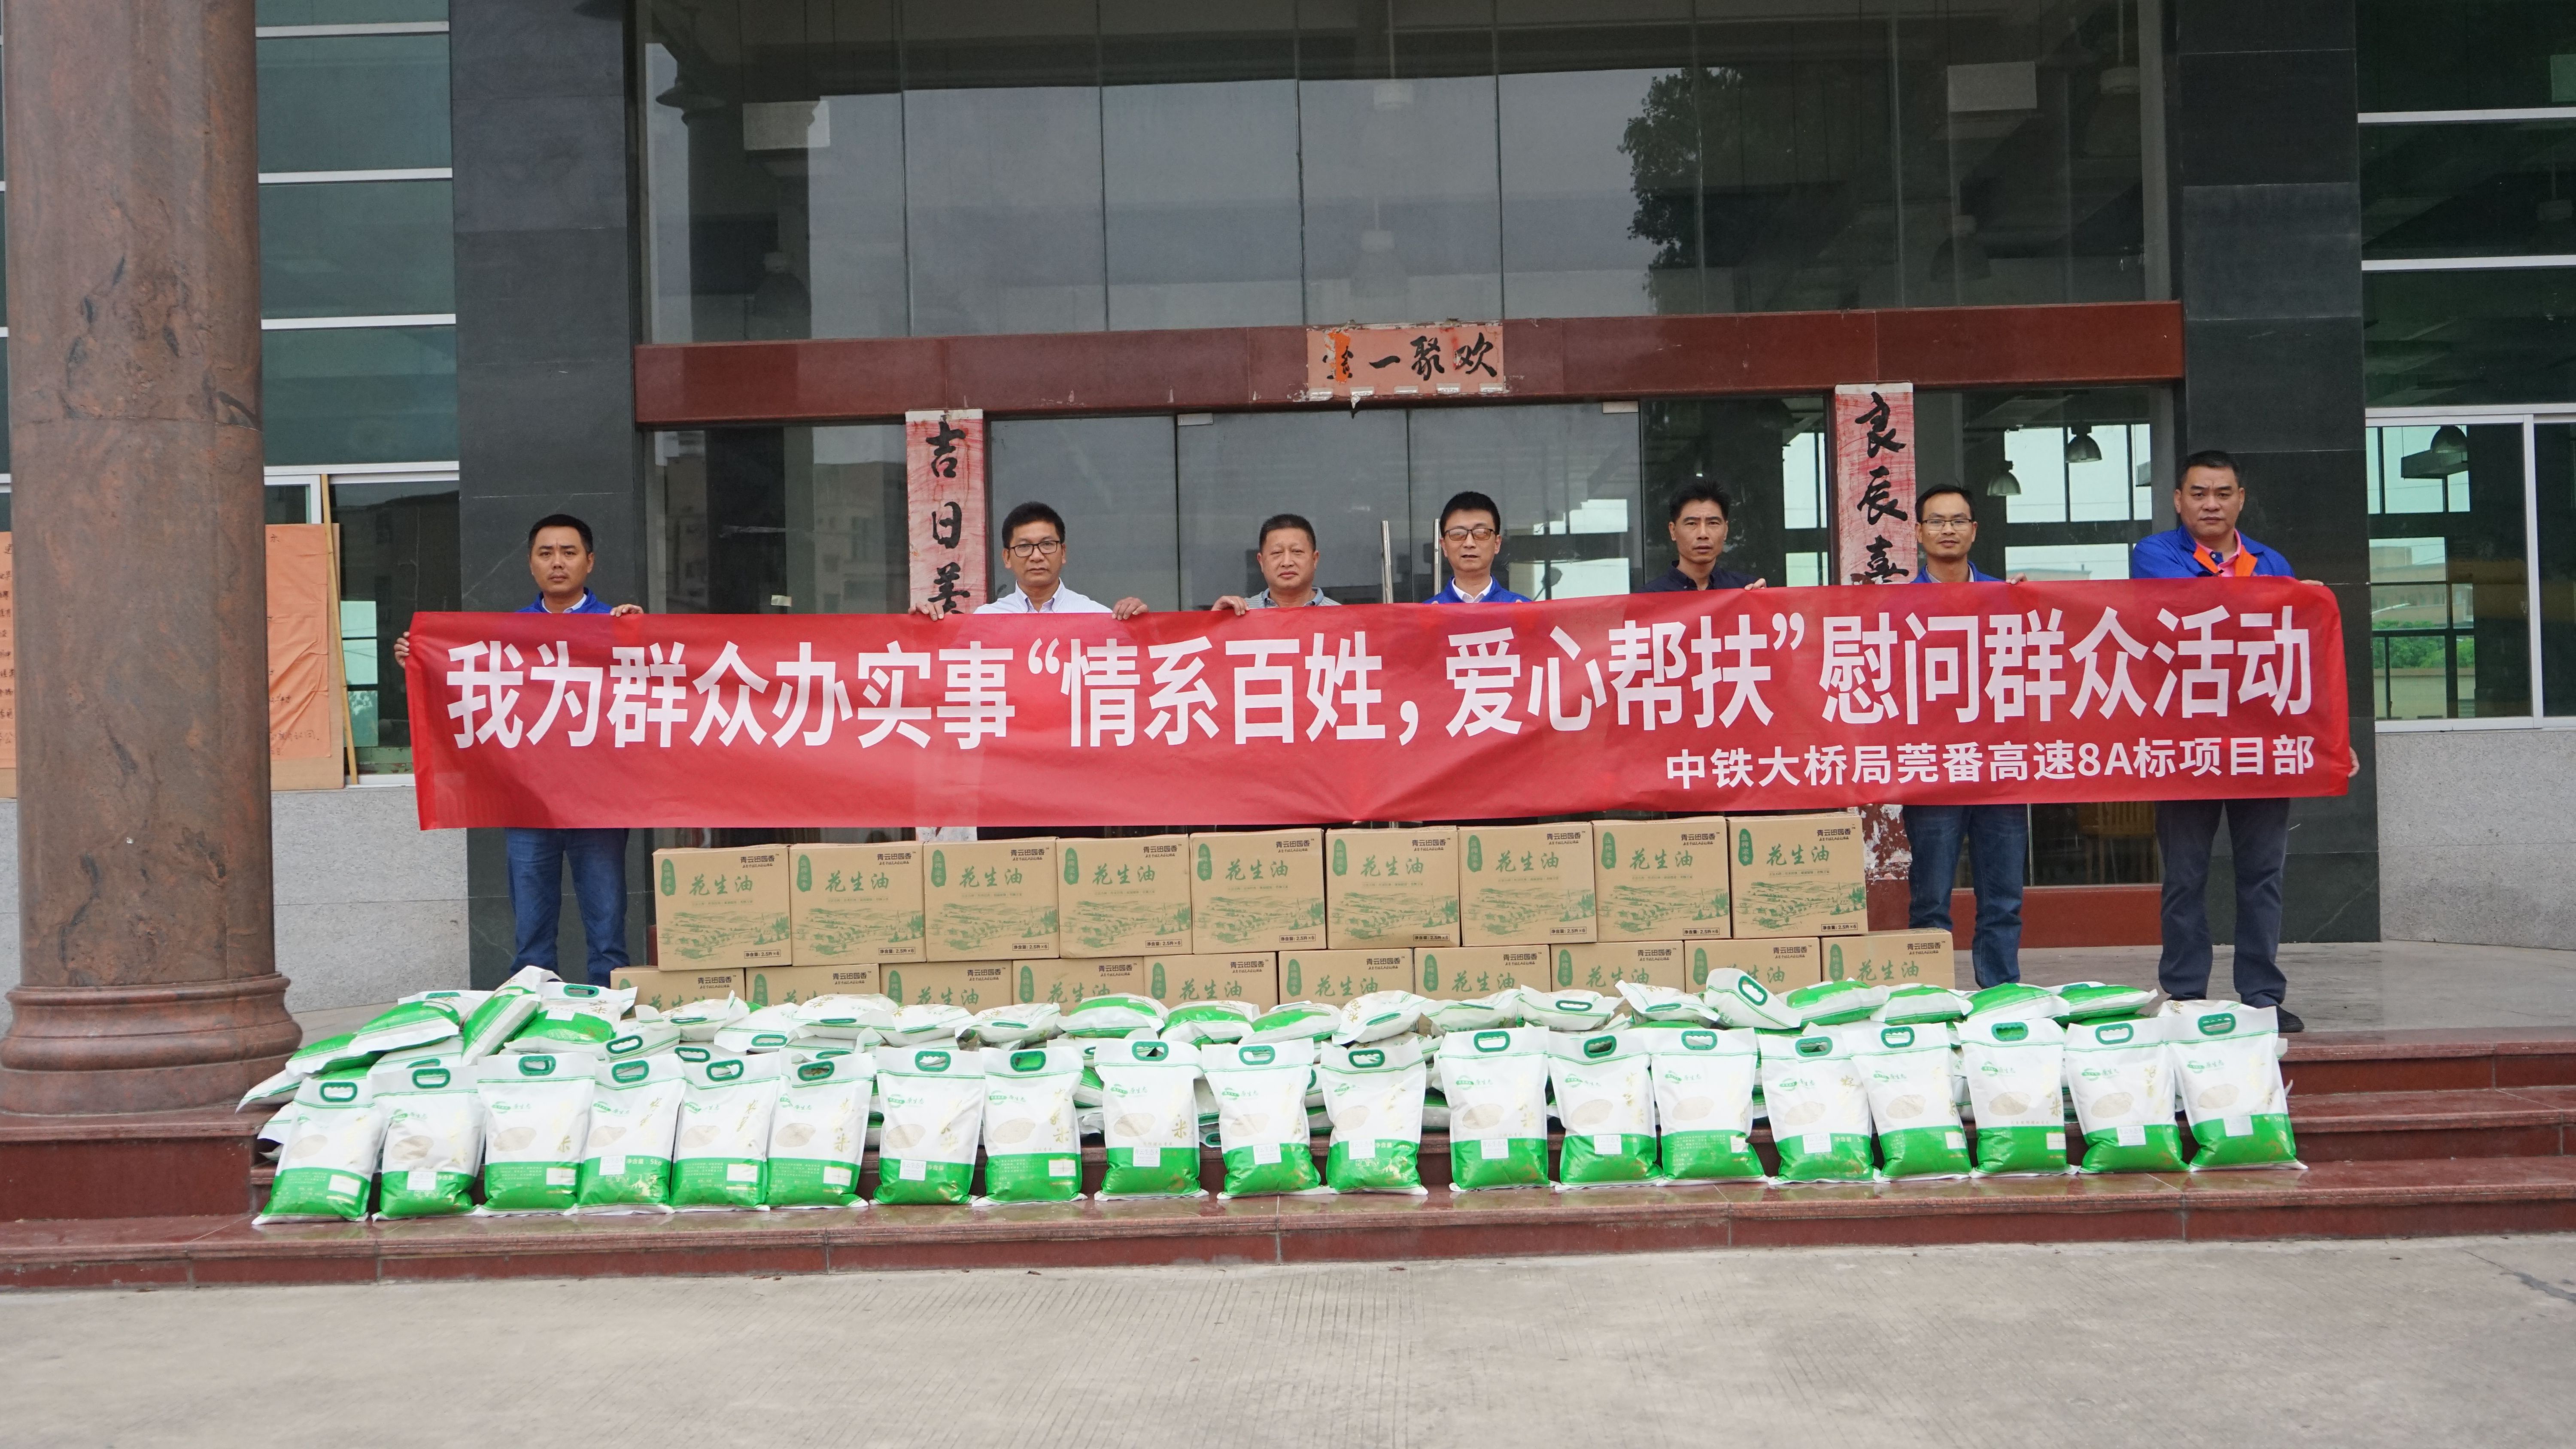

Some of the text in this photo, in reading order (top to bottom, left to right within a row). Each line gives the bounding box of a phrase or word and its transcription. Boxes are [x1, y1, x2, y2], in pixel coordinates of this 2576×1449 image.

[1667, 735, 2314, 789] 中铁大桥局莞番高速8A标项目部
[1496, 850, 1558, 872] 花生油
[1630, 848, 1692, 869] 花生油
[1767, 844, 1829, 865] 花生油
[1093, 864, 1155, 885] 花生油
[1226, 859, 1288, 880] 花生油
[1361, 855, 1423, 876] 花生油
[690, 874, 752, 895] 花生油
[826, 870, 889, 892] 花生油
[960, 866, 1022, 887] 花生油
[1727, 964, 1785, 983] 生油
[1857, 959, 1919, 981] 花生油
[1180, 979, 1242, 1000] 花生油
[1315, 976, 1378, 997] 花生油
[1452, 971, 1515, 992] 花生油
